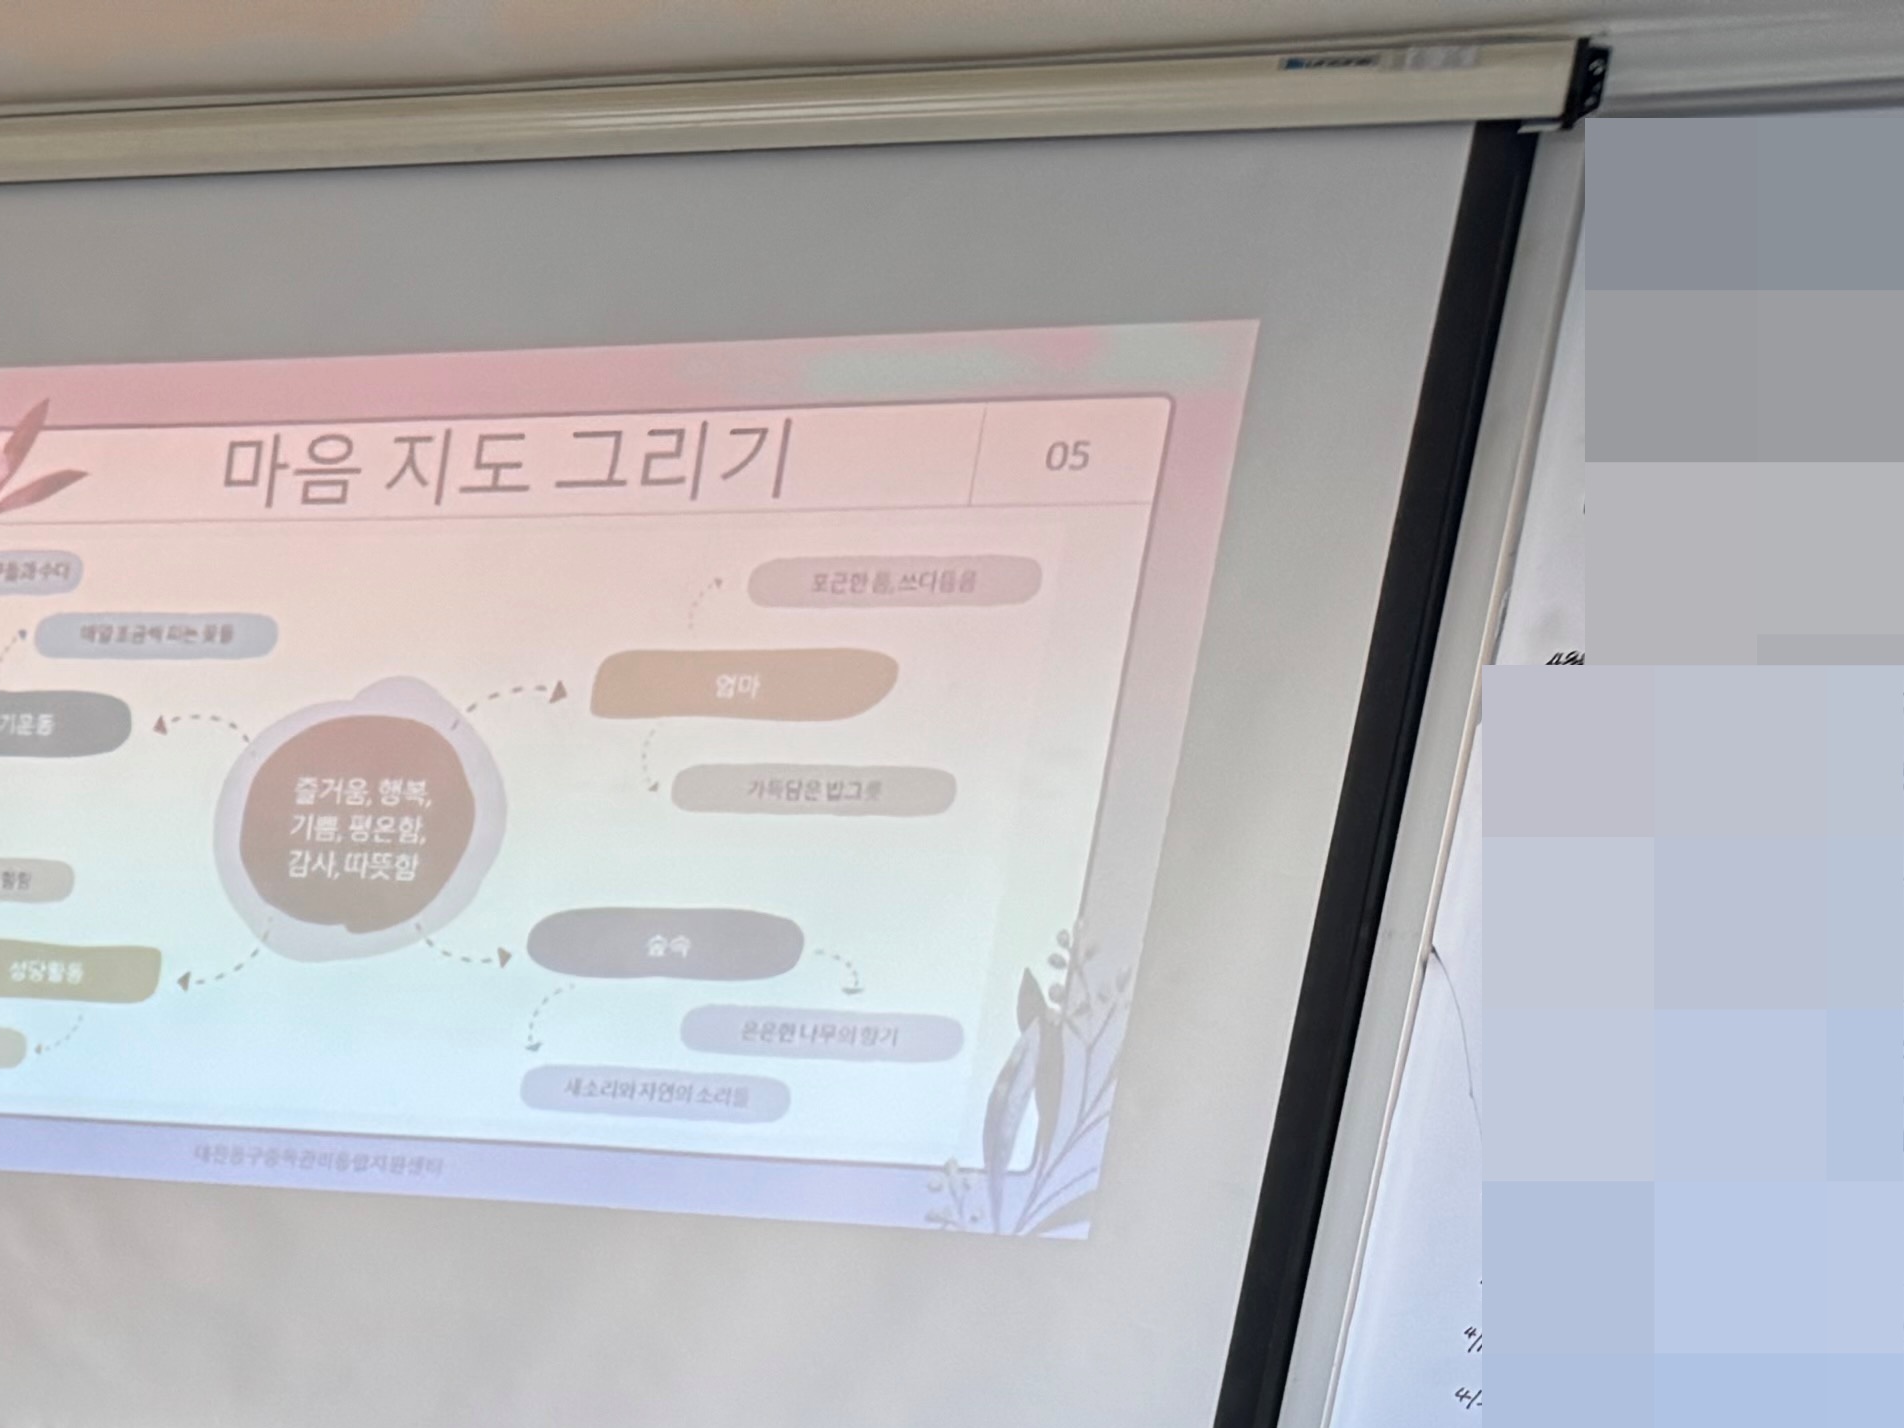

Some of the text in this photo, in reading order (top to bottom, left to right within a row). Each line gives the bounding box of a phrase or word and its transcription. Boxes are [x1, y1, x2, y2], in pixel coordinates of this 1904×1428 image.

[223, 417, 794, 508] 마음 지도 그리기
[1045, 441, 1090, 471] 05
[812, 571, 869, 594] 포근한
[716, 673, 760, 699] 엄마
[294, 776, 432, 808] 즐거움, 행복,
[290, 813, 427, 844] 기쁨, 평온함,
[287, 850, 420, 881] 감사, 따뜻함
[645, 934, 691, 959] 숲속
[8, 959, 85, 985] 성당활동
[740, 1020, 900, 1048] 은은한 나무의 향기
